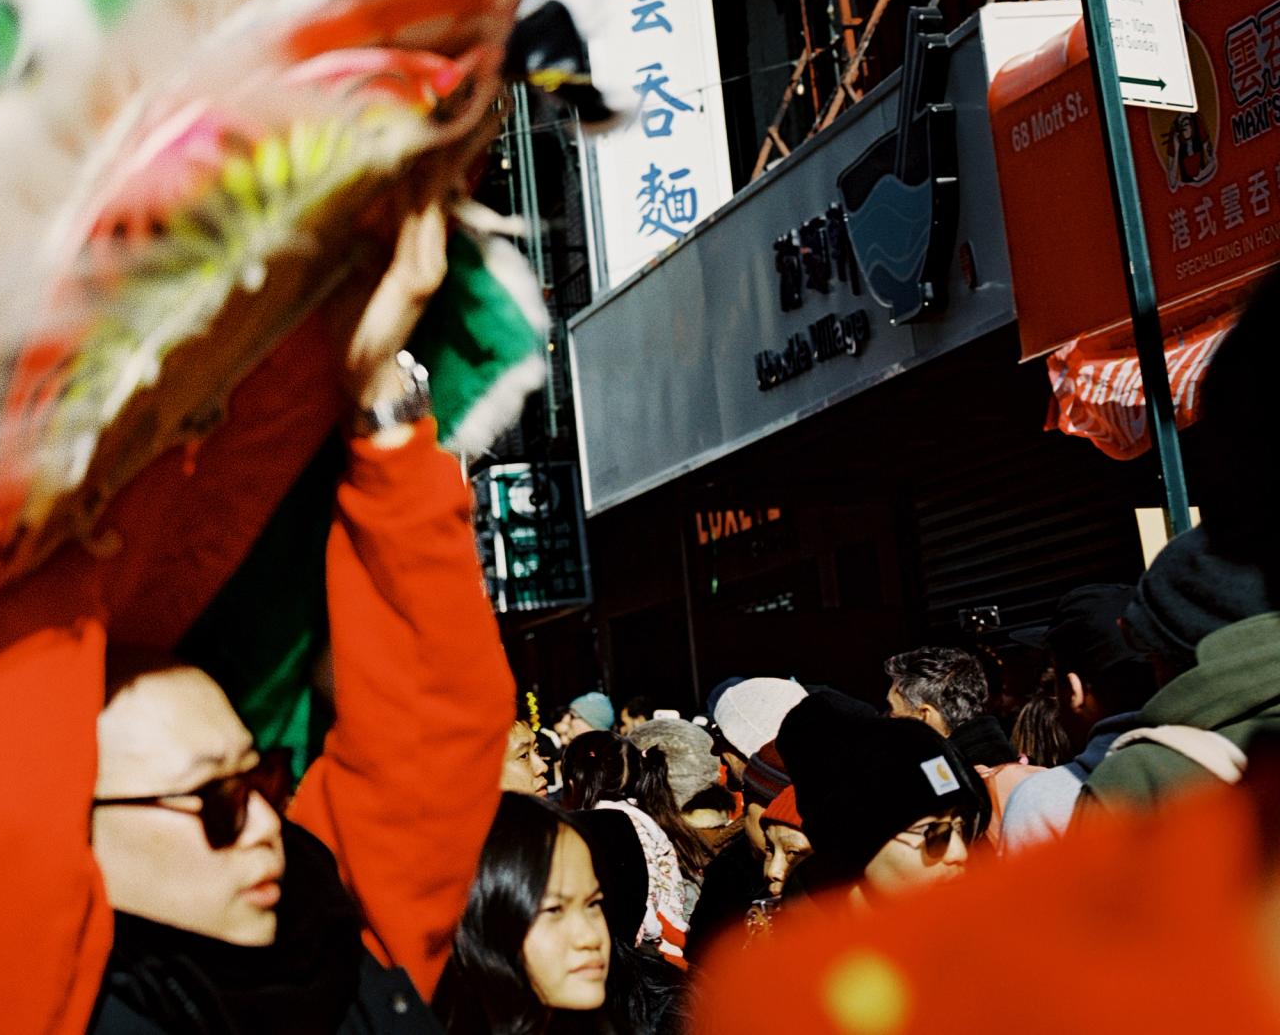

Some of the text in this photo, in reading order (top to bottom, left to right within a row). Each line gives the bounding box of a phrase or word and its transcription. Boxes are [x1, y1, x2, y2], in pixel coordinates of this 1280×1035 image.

[1011, 91, 1089, 152] 68 Mott St.
[1168, 163, 1280, 253] 港式雲吞
[1175, 239, 1242, 281] SPECIALIZING
[1240, 235, 1255, 254] IN
